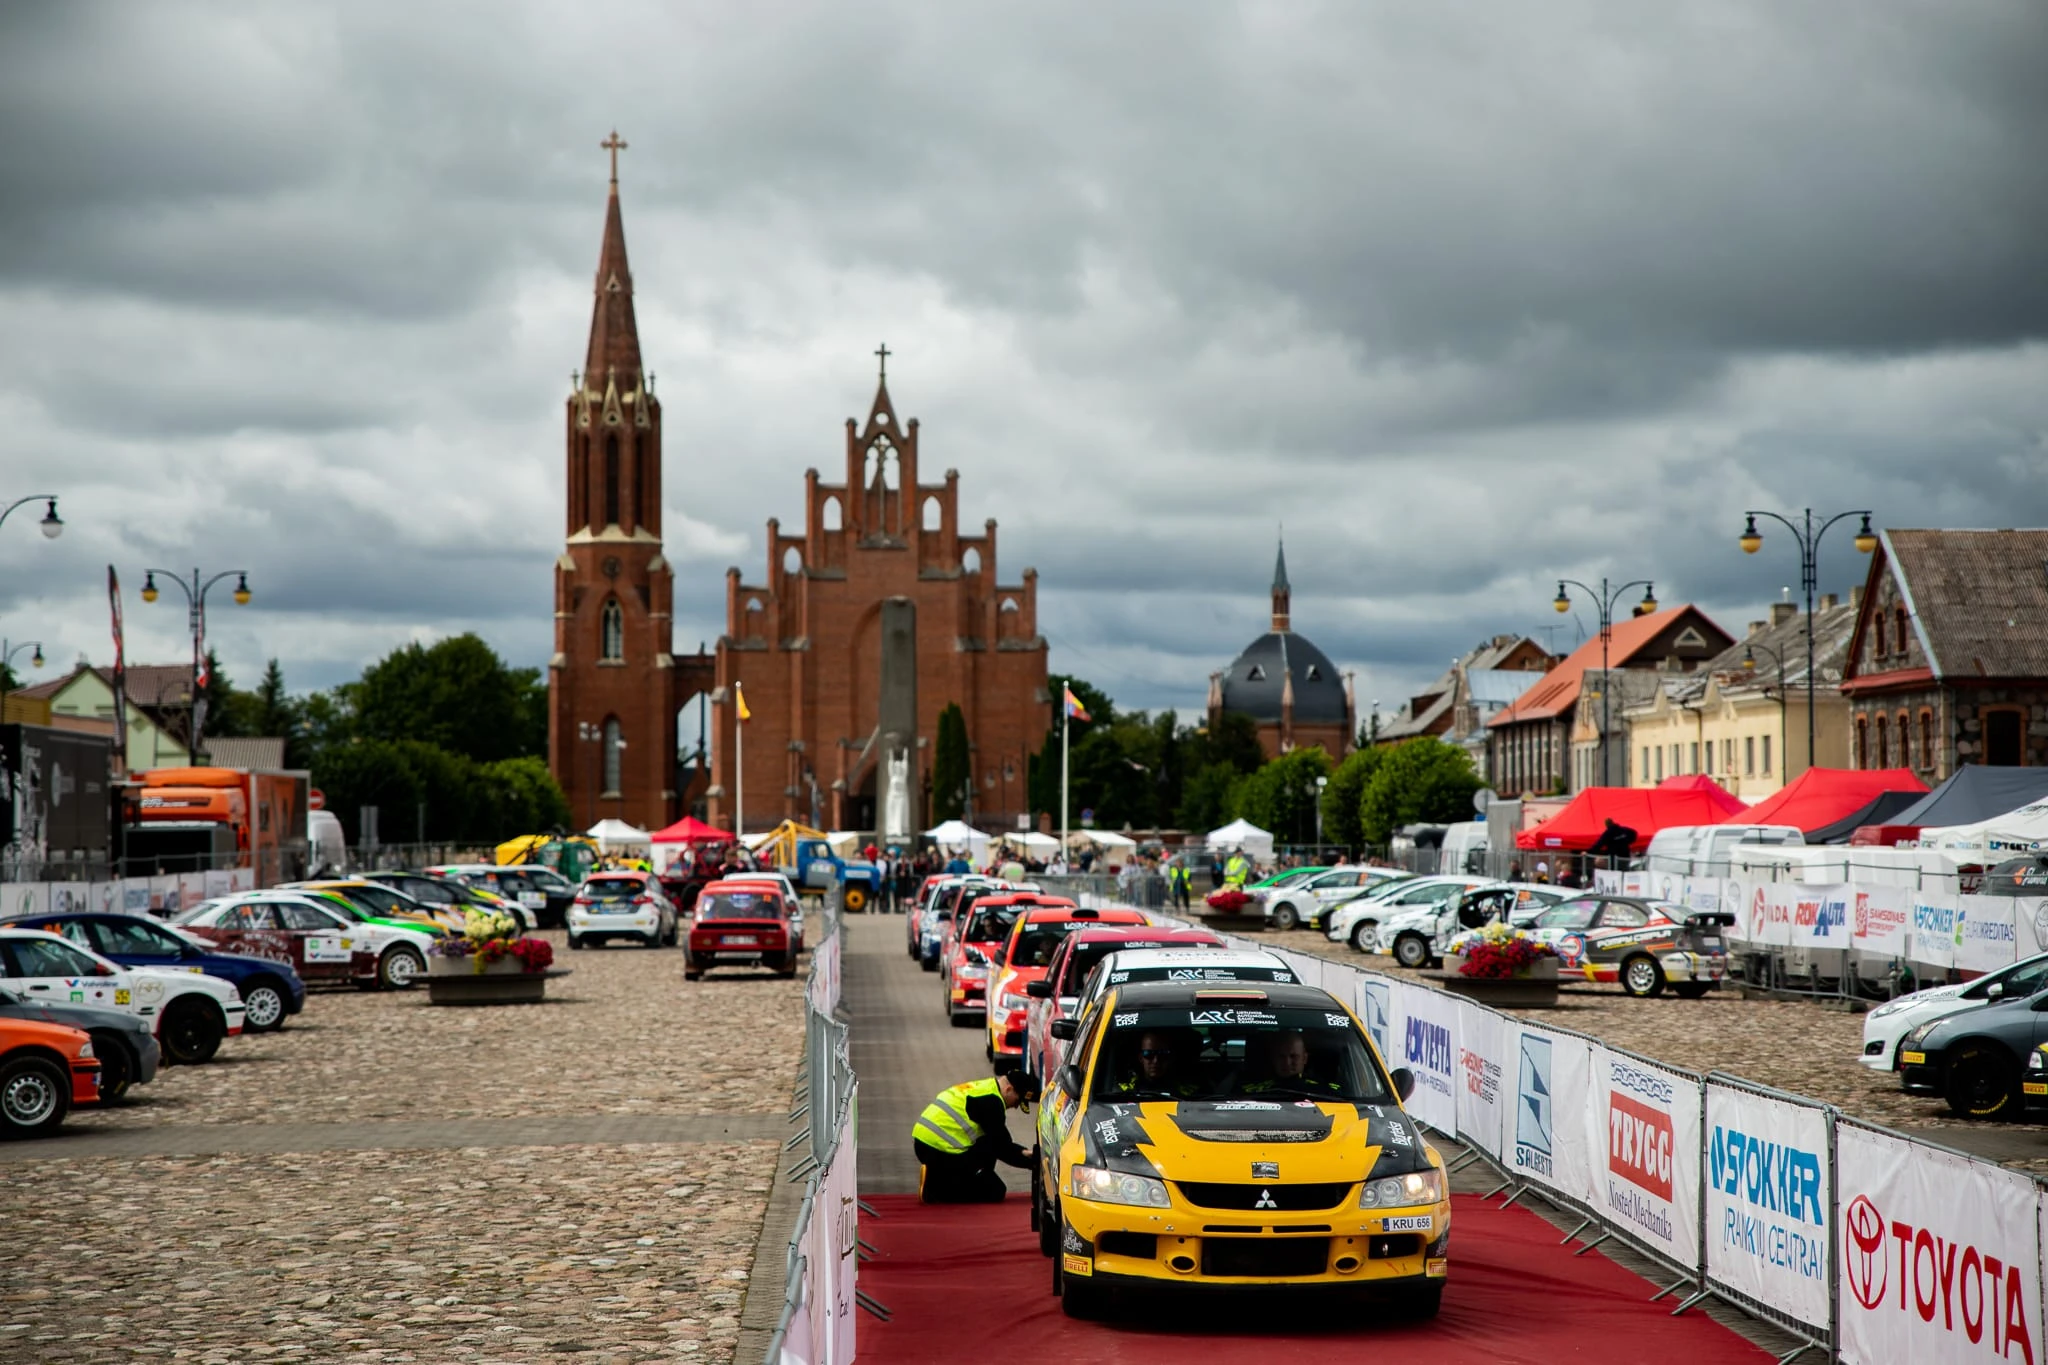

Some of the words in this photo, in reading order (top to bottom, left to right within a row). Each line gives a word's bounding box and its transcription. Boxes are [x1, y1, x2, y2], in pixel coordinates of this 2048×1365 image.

[1795, 896, 1845, 936] ROKAUTA
[1190, 1009, 1236, 1024] LARČ
[1610, 1108, 1671, 1184] TRYGG
[1725, 1130, 1823, 1226] STOKKER
[1392, 1218, 1413, 1229] KRU
[1416, 1217, 1430, 1228] 656
[1609, 1180, 1632, 1218] Nosted
[1633, 1193, 1672, 1242] Mechanika
[1768, 1225, 1823, 1281] CENTRAI
[1892, 1220, 2034, 1365] TOYOTA
